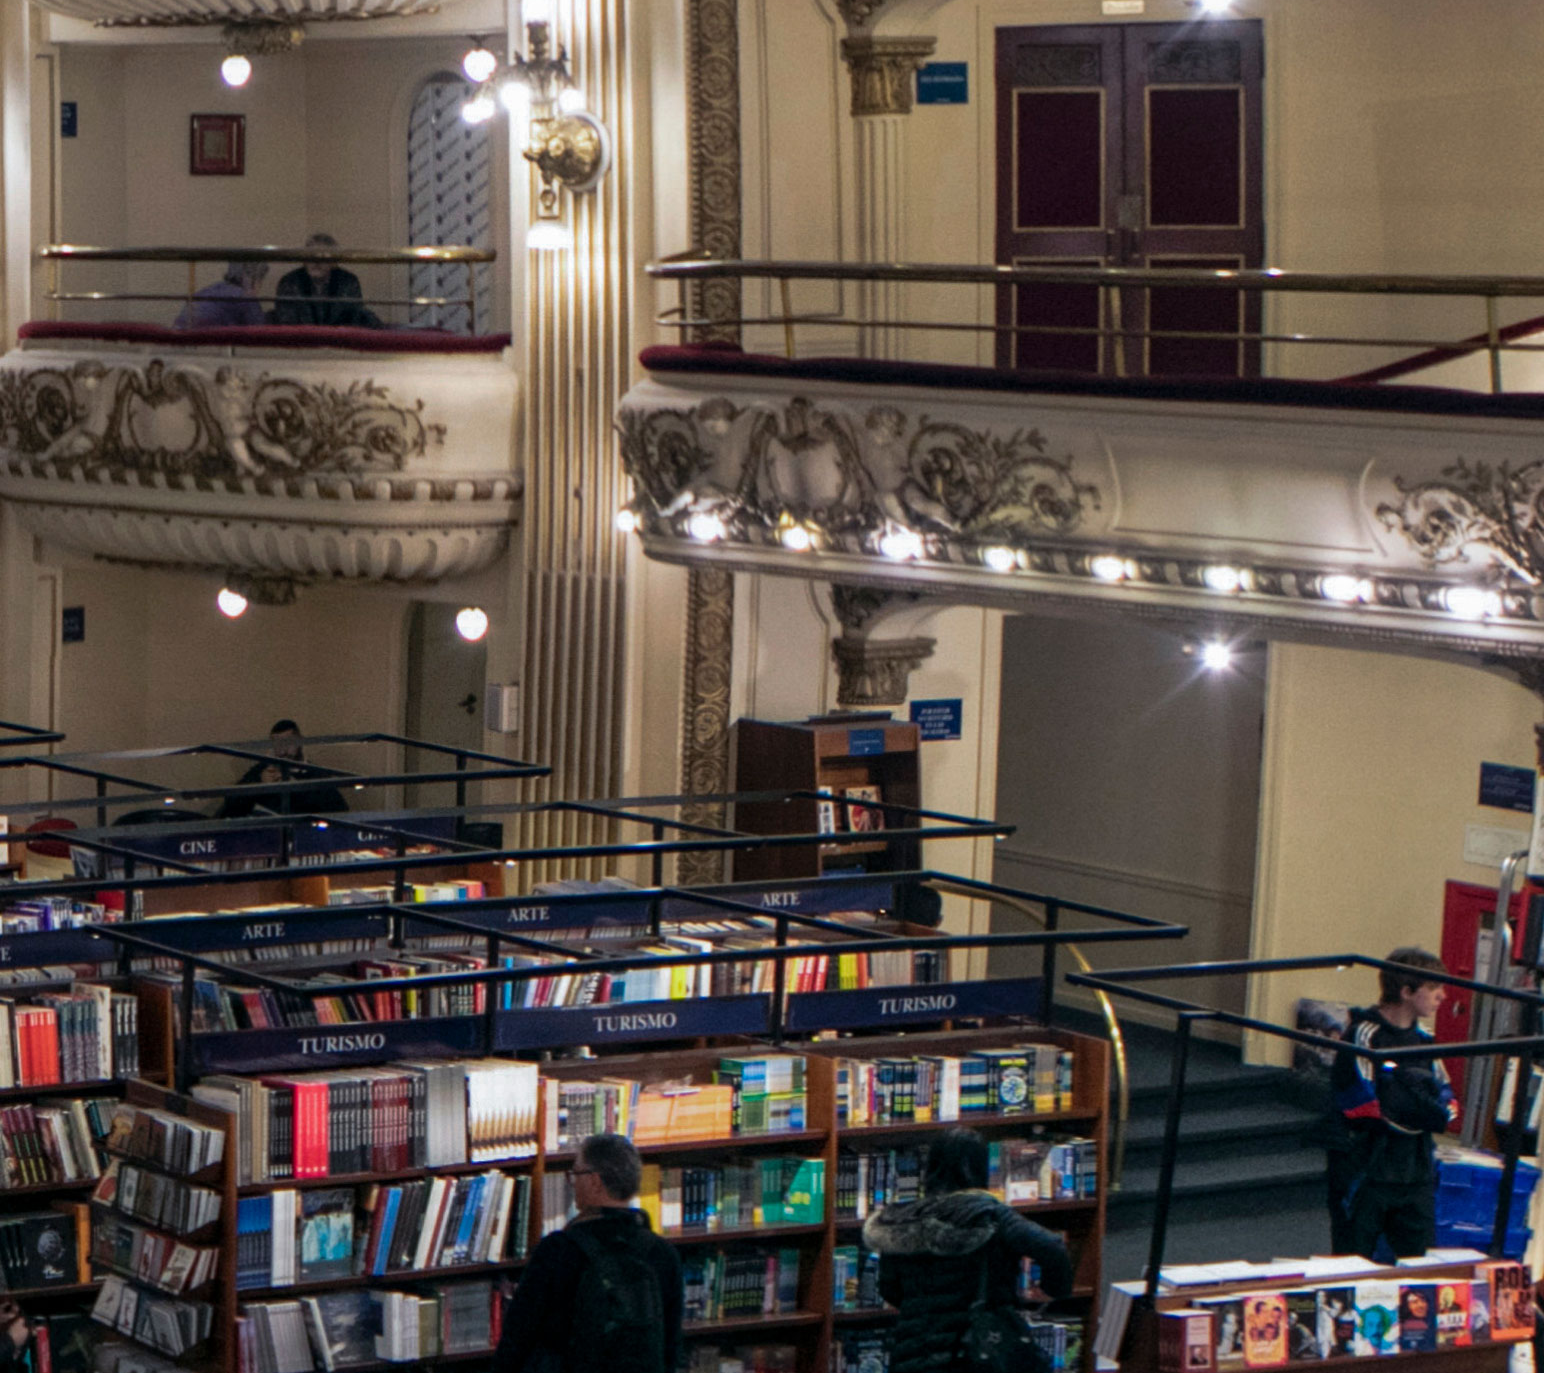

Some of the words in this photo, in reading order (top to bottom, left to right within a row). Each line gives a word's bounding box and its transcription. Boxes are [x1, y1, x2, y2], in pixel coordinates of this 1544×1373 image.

[179, 839, 217, 855] CINE
[762, 891, 801, 908] ARTE
[507, 906, 550, 923] ARTE
[242, 922, 286, 940] ARTE
[878, 994, 957, 1016] TURISMO
[593, 1012, 678, 1033] TURISMO
[298, 1033, 386, 1055] TURISMO
